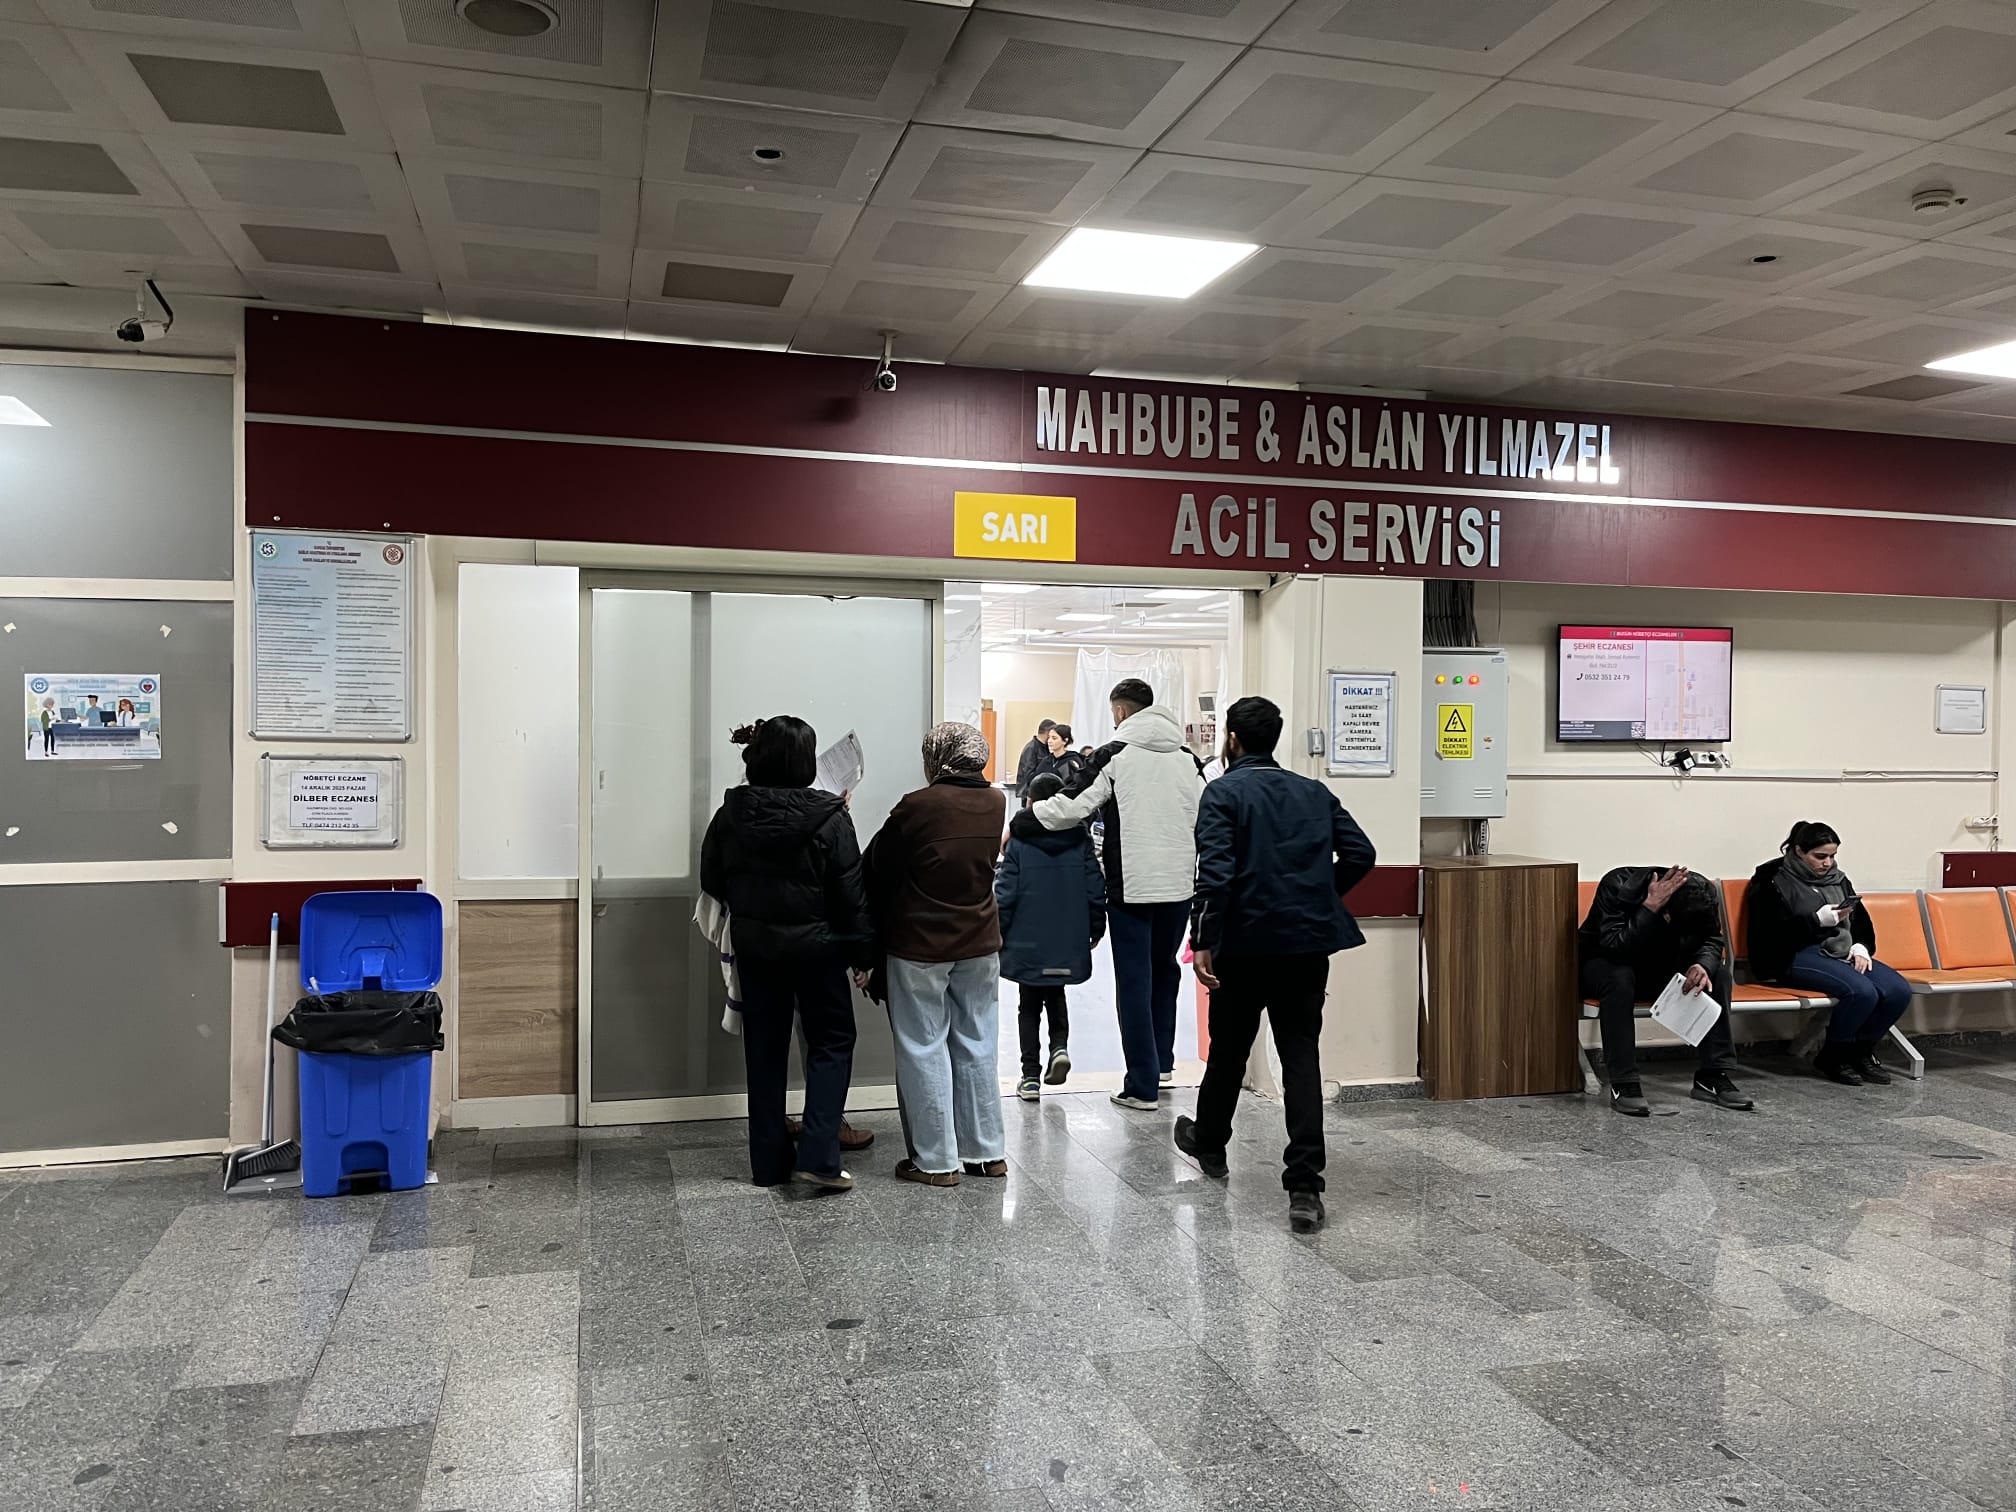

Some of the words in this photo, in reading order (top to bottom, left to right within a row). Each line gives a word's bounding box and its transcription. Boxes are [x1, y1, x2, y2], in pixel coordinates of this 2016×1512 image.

[1037, 387, 1240, 461] MAHBUBE
[1256, 401, 1281, 462] &
[1296, 403, 1425, 472] ASLAN
[1438, 414, 1620, 484] YILMAZEL
[982, 512, 1047, 544] SARI
[1573, 643, 1595, 651] ŞEHİR
[1598, 643, 1633, 651] ECZANESİ
[1343, 685, 1373, 695] DİKKAT
[293, 794, 328, 802] DİLBER
